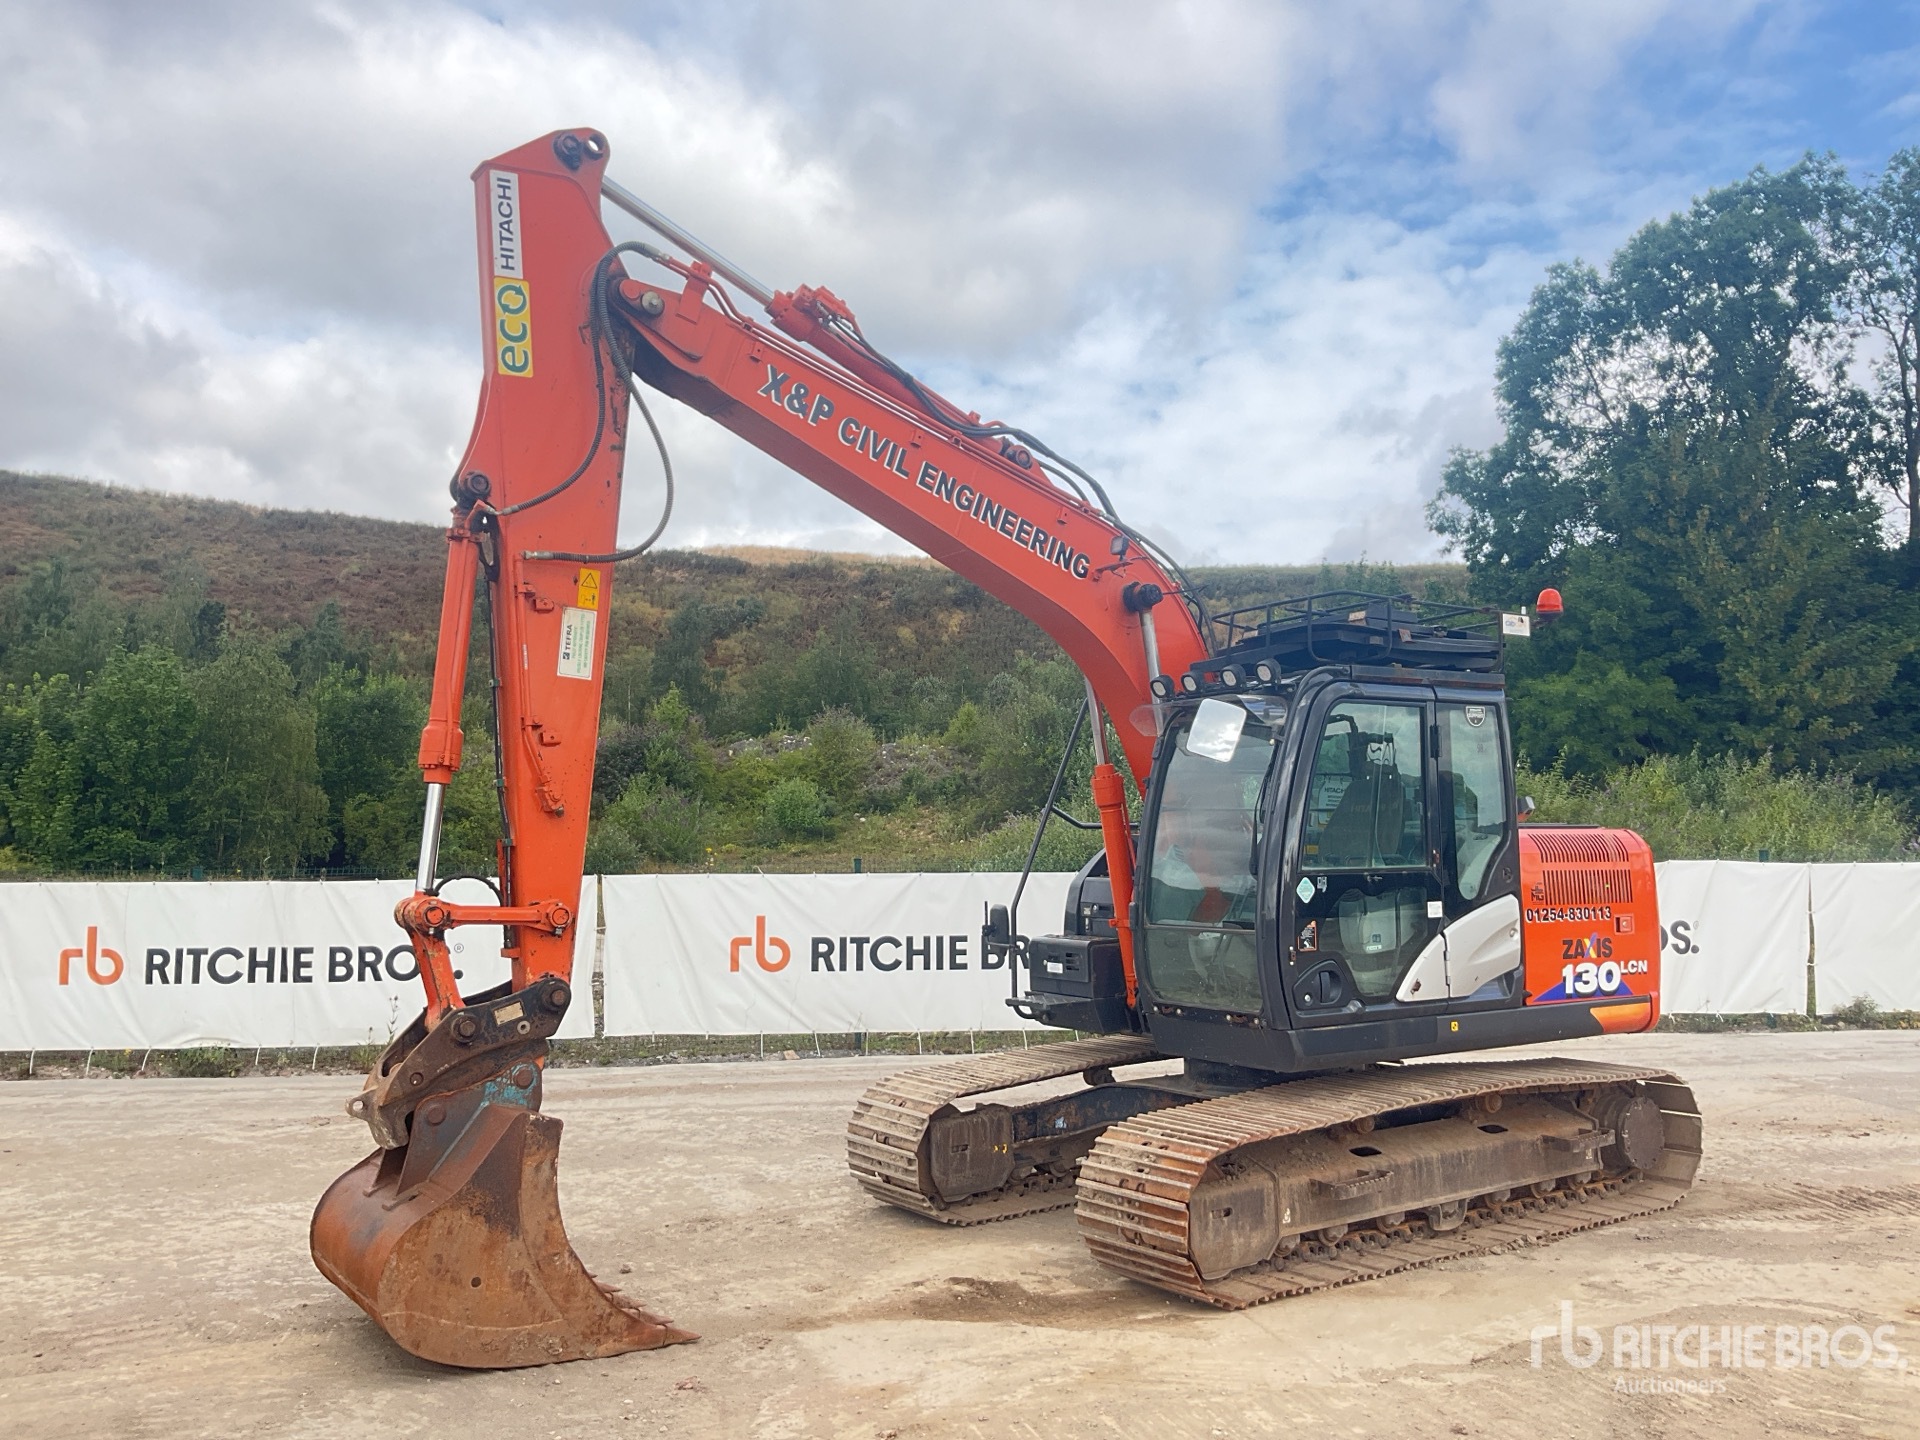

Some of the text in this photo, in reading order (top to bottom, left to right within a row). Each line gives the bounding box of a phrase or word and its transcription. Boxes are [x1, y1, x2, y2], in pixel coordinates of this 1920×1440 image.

[496, 177, 516, 271] HITACHI
[757, 364, 1092, 580] X&P CIVIL ENGINEERING
[1526, 906, 1612, 922] 01254-830113
[1660, 920, 1700, 954] S.
[58, 926, 464, 985] rb RITCHIE BRO.
[730, 915, 1030, 973] rb RITCHIE BR
[1562, 932, 1613, 959] ZAXIS
[1562, 959, 1648, 998] 130 LCN
